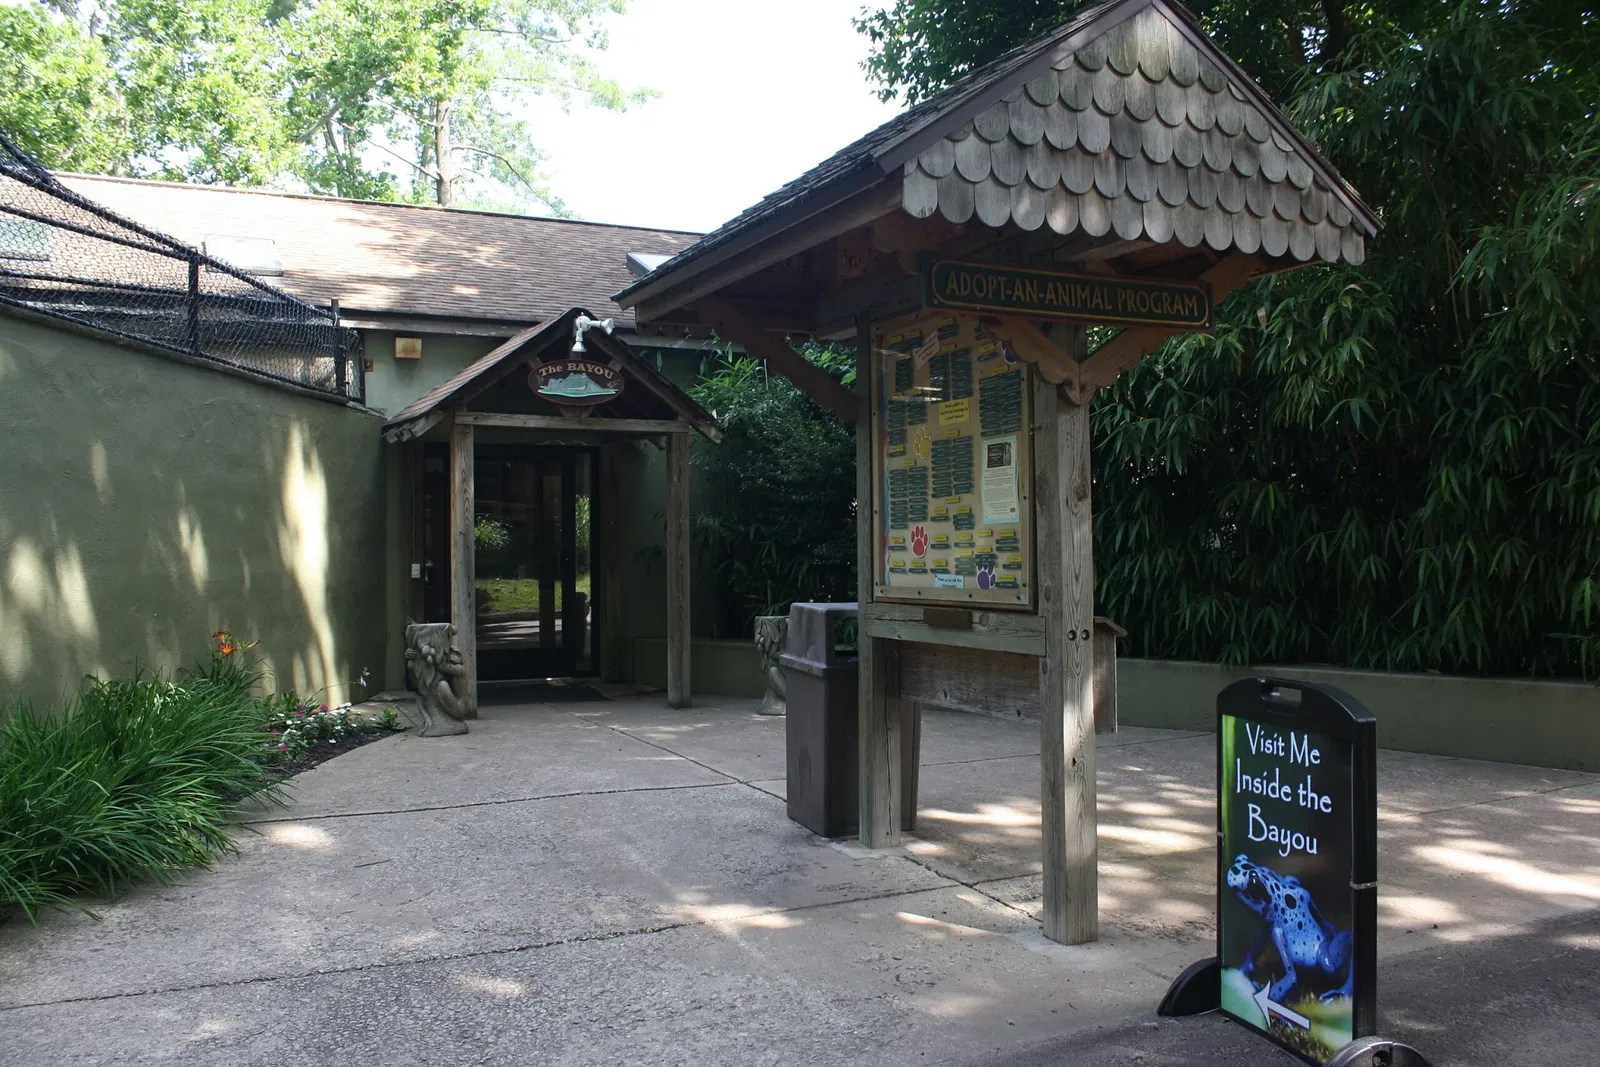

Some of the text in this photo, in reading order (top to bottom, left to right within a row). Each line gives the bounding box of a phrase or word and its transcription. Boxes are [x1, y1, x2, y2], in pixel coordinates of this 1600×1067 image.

[945, 270, 1198, 317] ADOPT-AN-ANIMAL PROGRAM
[539, 362, 614, 379] The BAYOU
[1245, 722, 1322, 767] Visit Me
[1235, 757, 1333, 814] Inside the
[1247, 803, 1318, 858] Bayou
